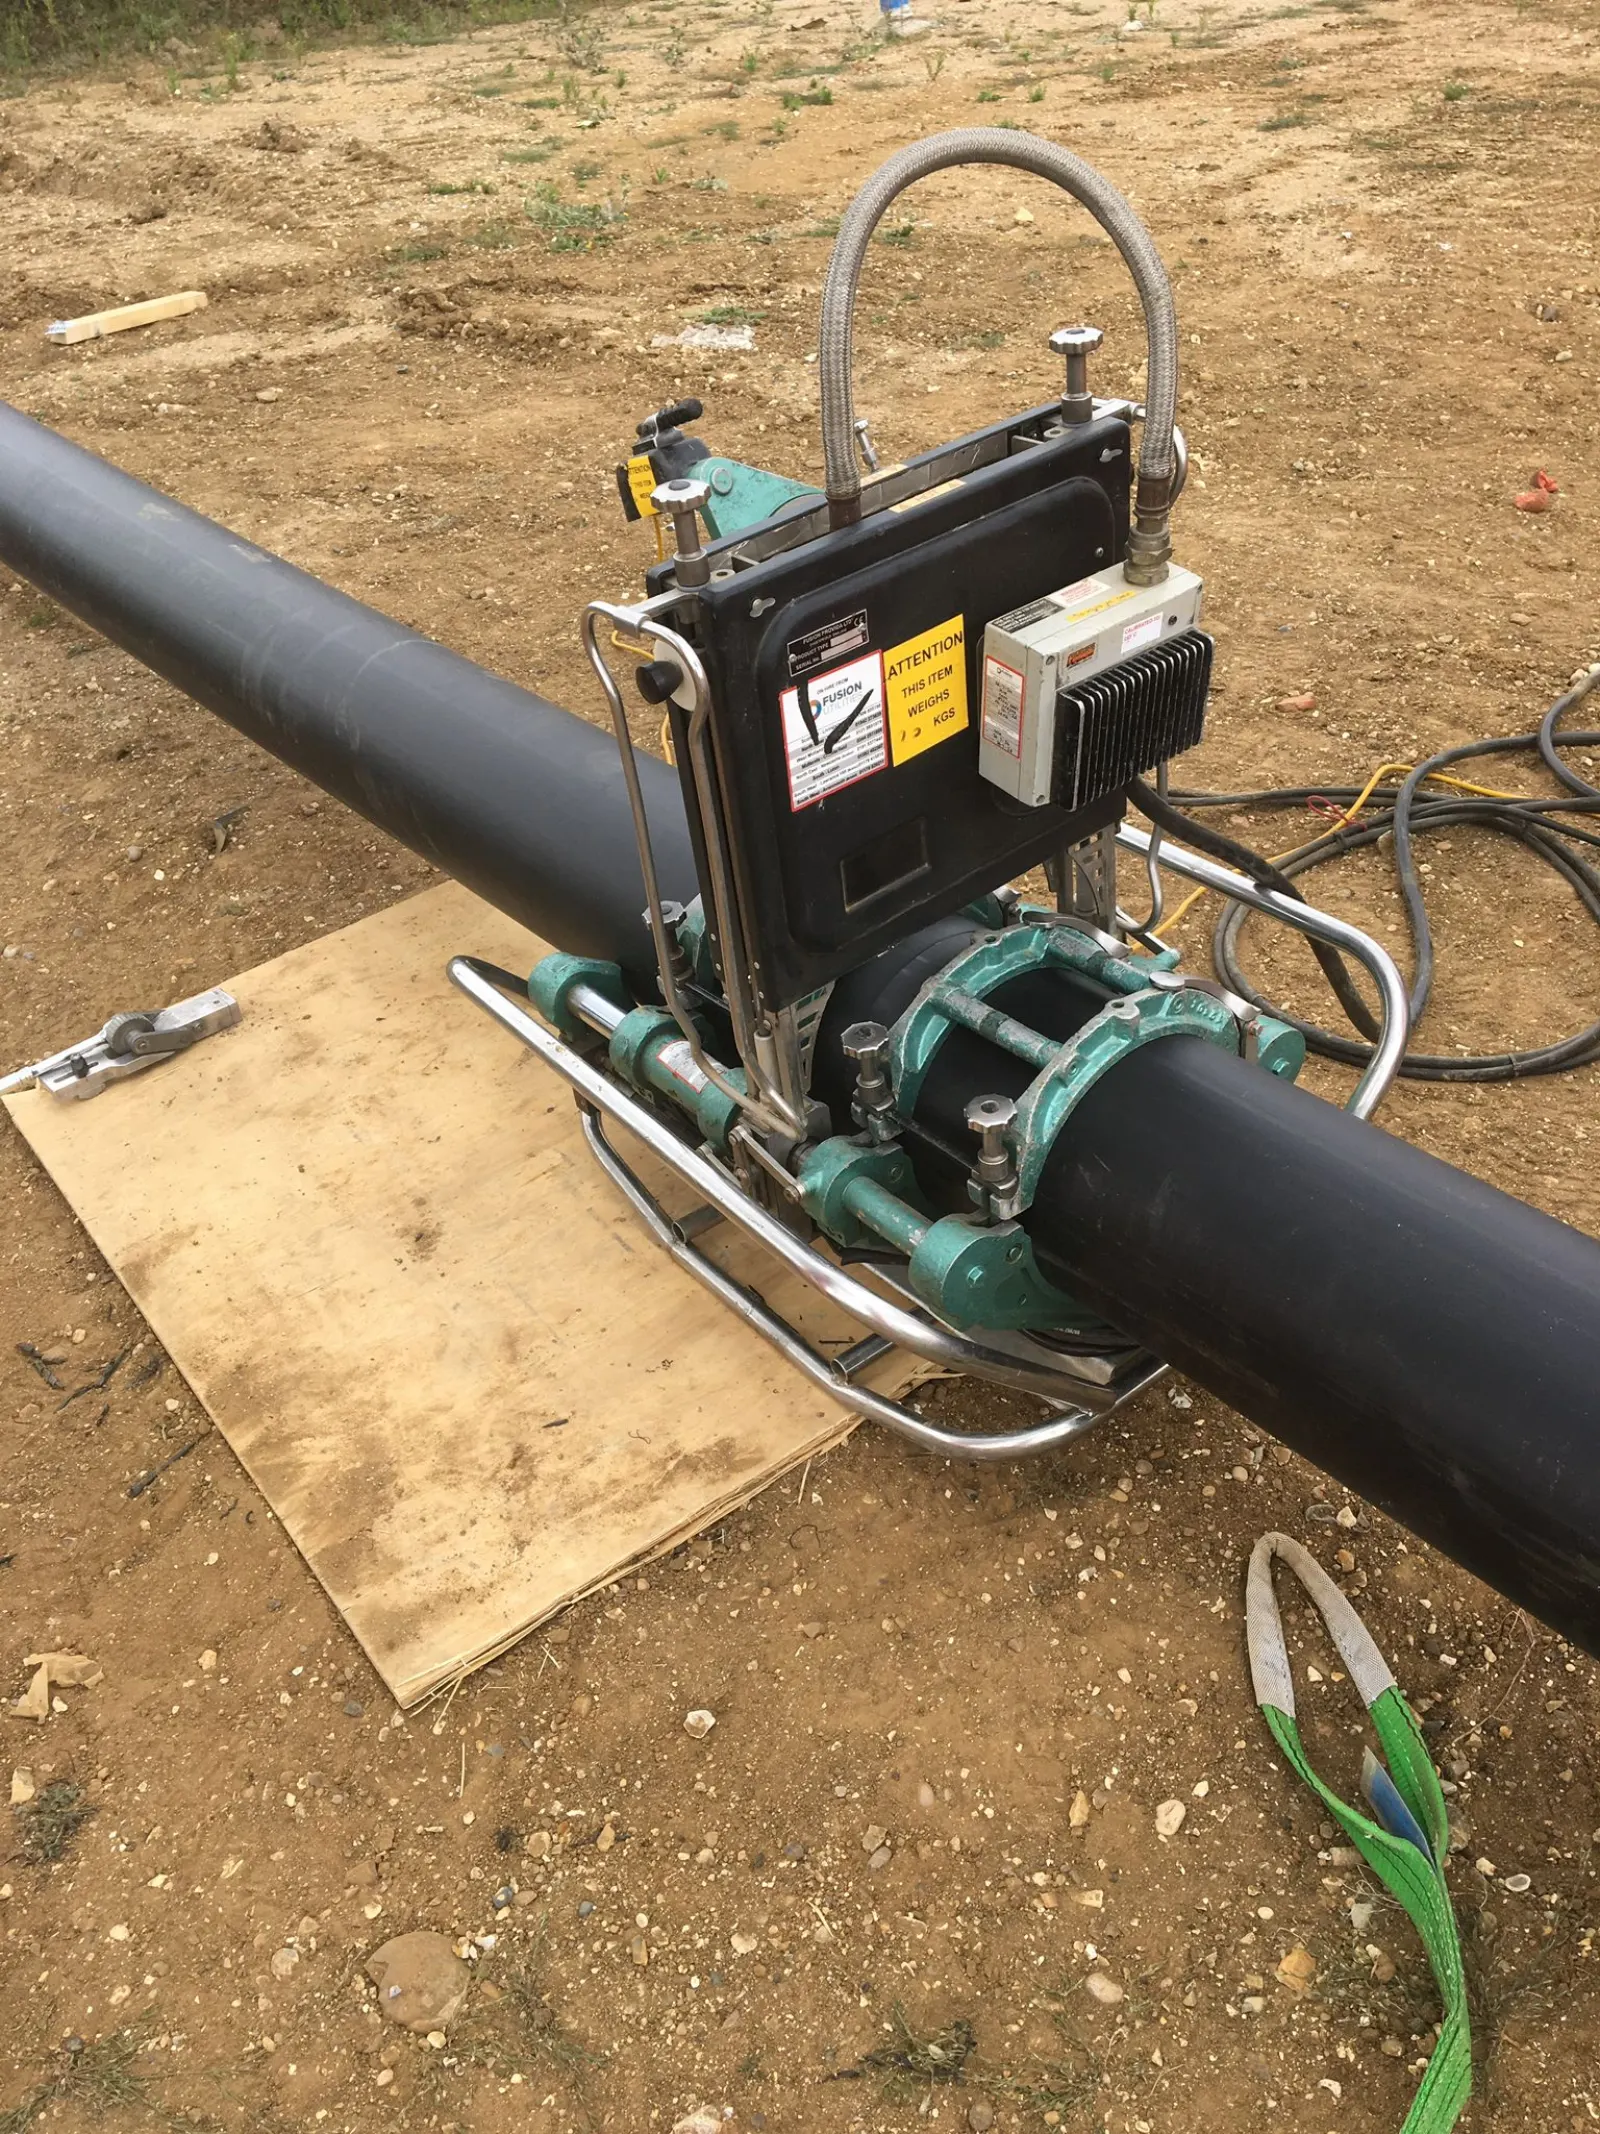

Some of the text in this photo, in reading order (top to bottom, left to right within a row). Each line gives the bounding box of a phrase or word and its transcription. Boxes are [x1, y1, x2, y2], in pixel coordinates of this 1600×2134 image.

[803, 633, 821, 644] FUSION
[817, 643, 829, 651] TYPE
[796, 660, 811, 670] SERIAL
[887, 631, 963, 680] ATTENTION
[836, 676, 848, 686] FROM
[902, 665, 953, 698] THIS ITEM
[823, 681, 861, 705] FUSION
[823, 691, 862, 715] UTILITIES
[908, 689, 950, 717] WEIGHS
[934, 708, 955, 726] KGS
